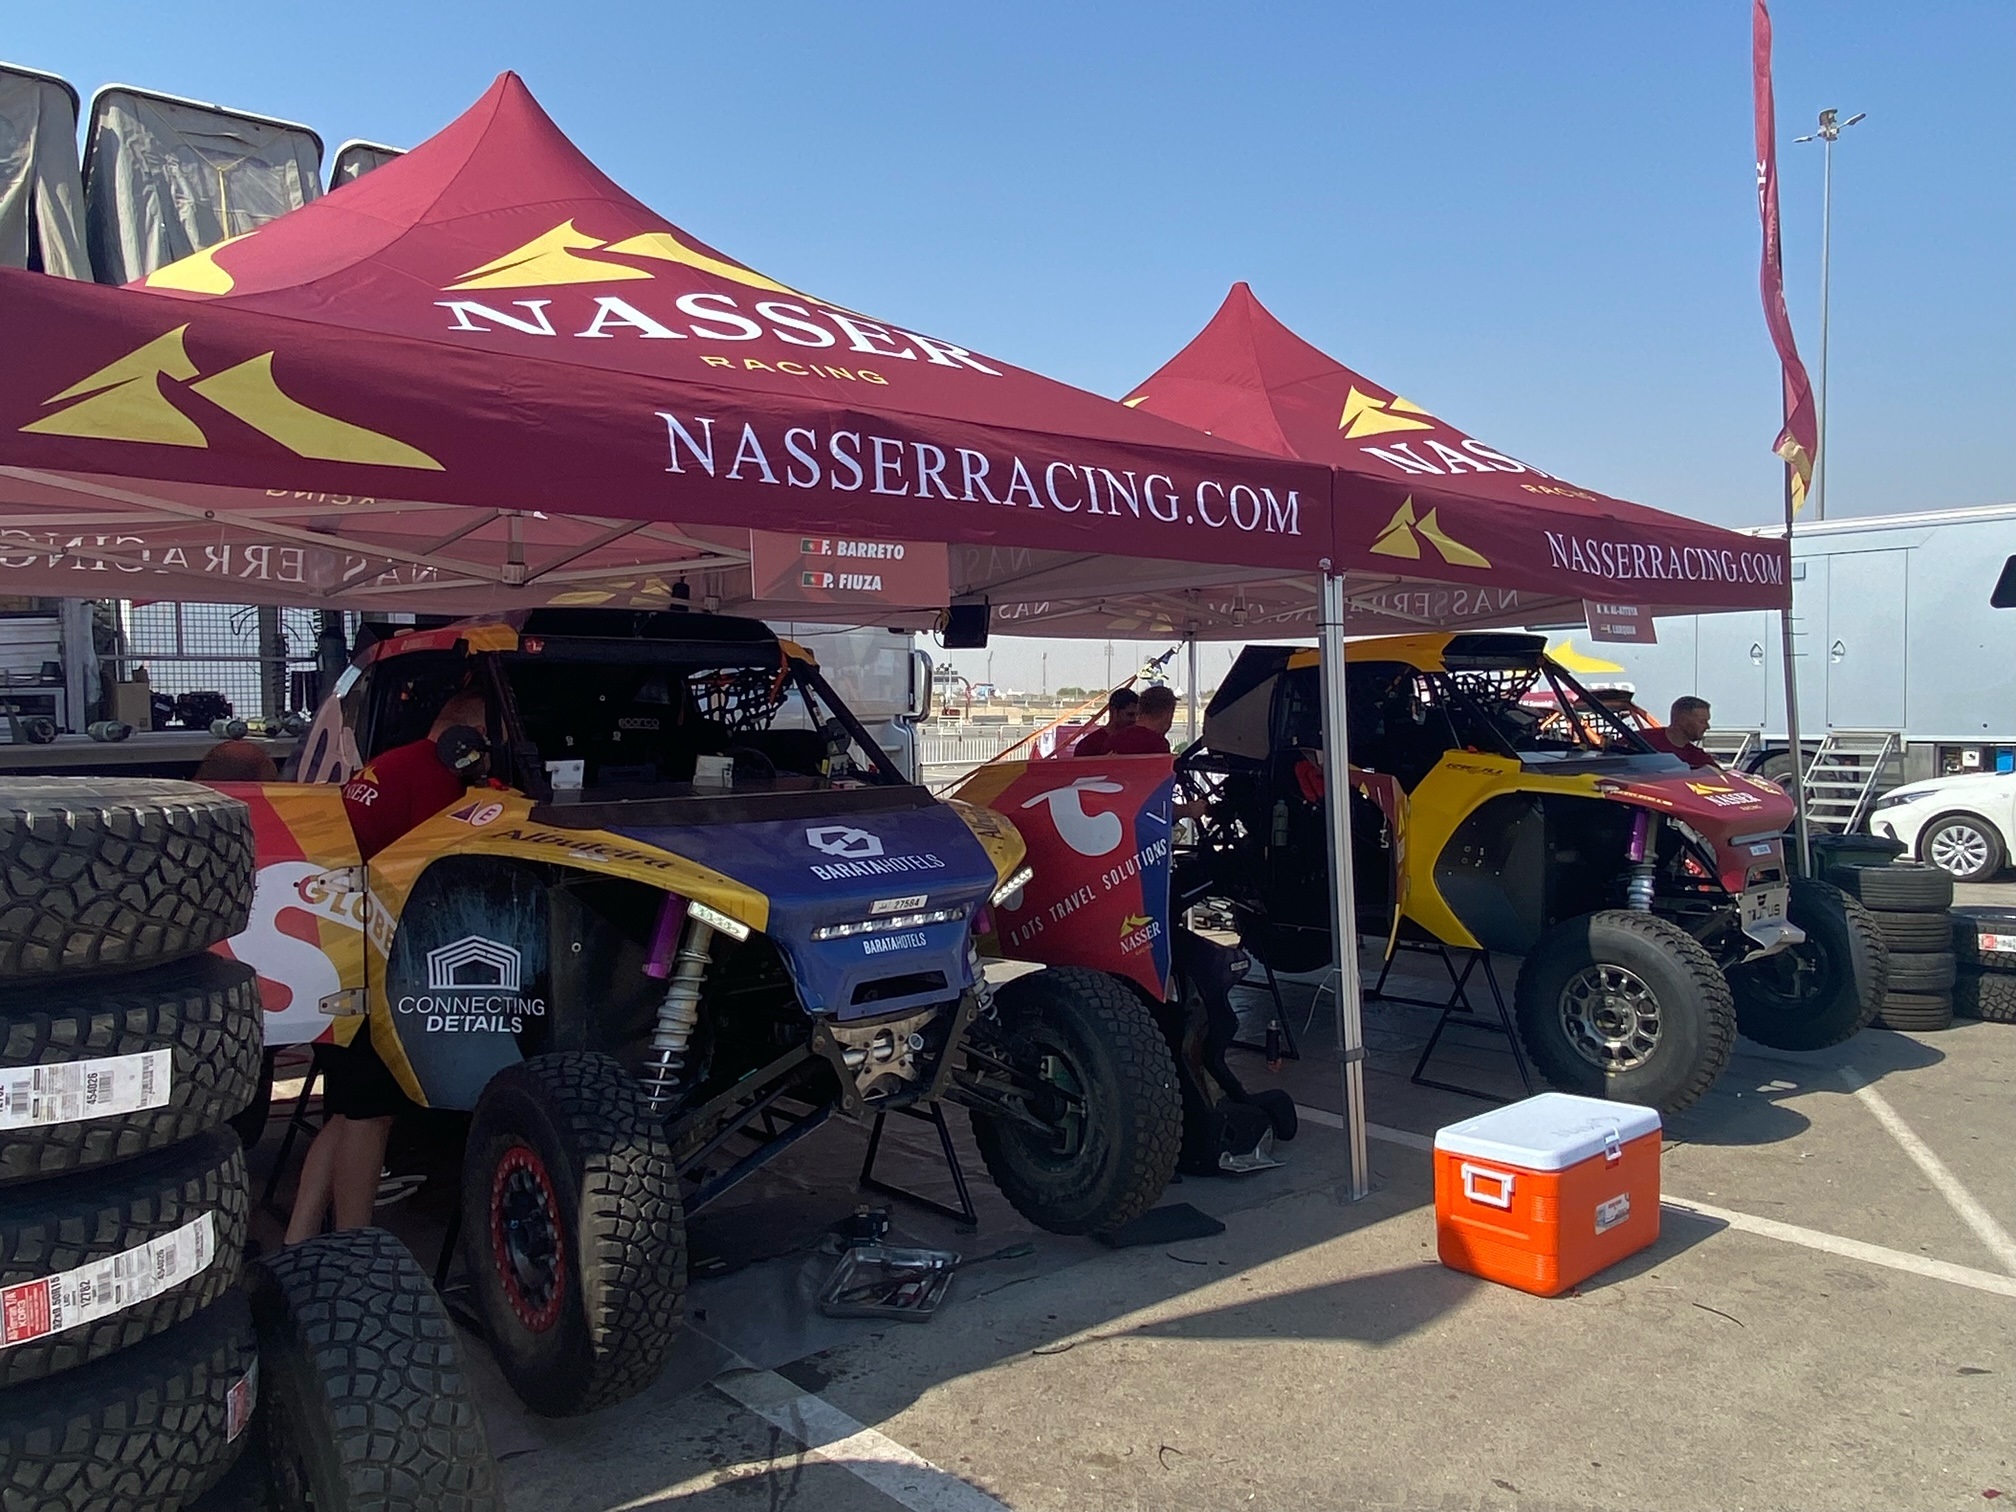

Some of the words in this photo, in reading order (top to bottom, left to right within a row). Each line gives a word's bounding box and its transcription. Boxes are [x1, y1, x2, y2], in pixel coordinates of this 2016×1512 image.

[434, 293, 1003, 377] NASSER
[700, 355, 890, 385] RACING
[654, 411, 1303, 535] NASSERRACING.COM
[821, 539, 832, 555] F.
[837, 541, 904, 560] BARRETO
[1543, 530, 1783, 585] NASSERRACING.COM
[823, 573, 834, 589] P.
[839, 574, 882, 591] FIUZA
[810, 854, 945, 880] BARATAHOTELS
[1049, 885, 1096, 922] TRAVEL
[1102, 838, 1167, 891] SOLUTIONS
[863, 932, 926, 955] BARATAHOTELS
[1119, 921, 1162, 955] NASSER
[398, 996, 545, 1016] CONNECTING
[426, 1015, 523, 1033] DETAILS
[86, 1072, 98, 1105] 454026
[79, 1279, 91, 1309] 12782
